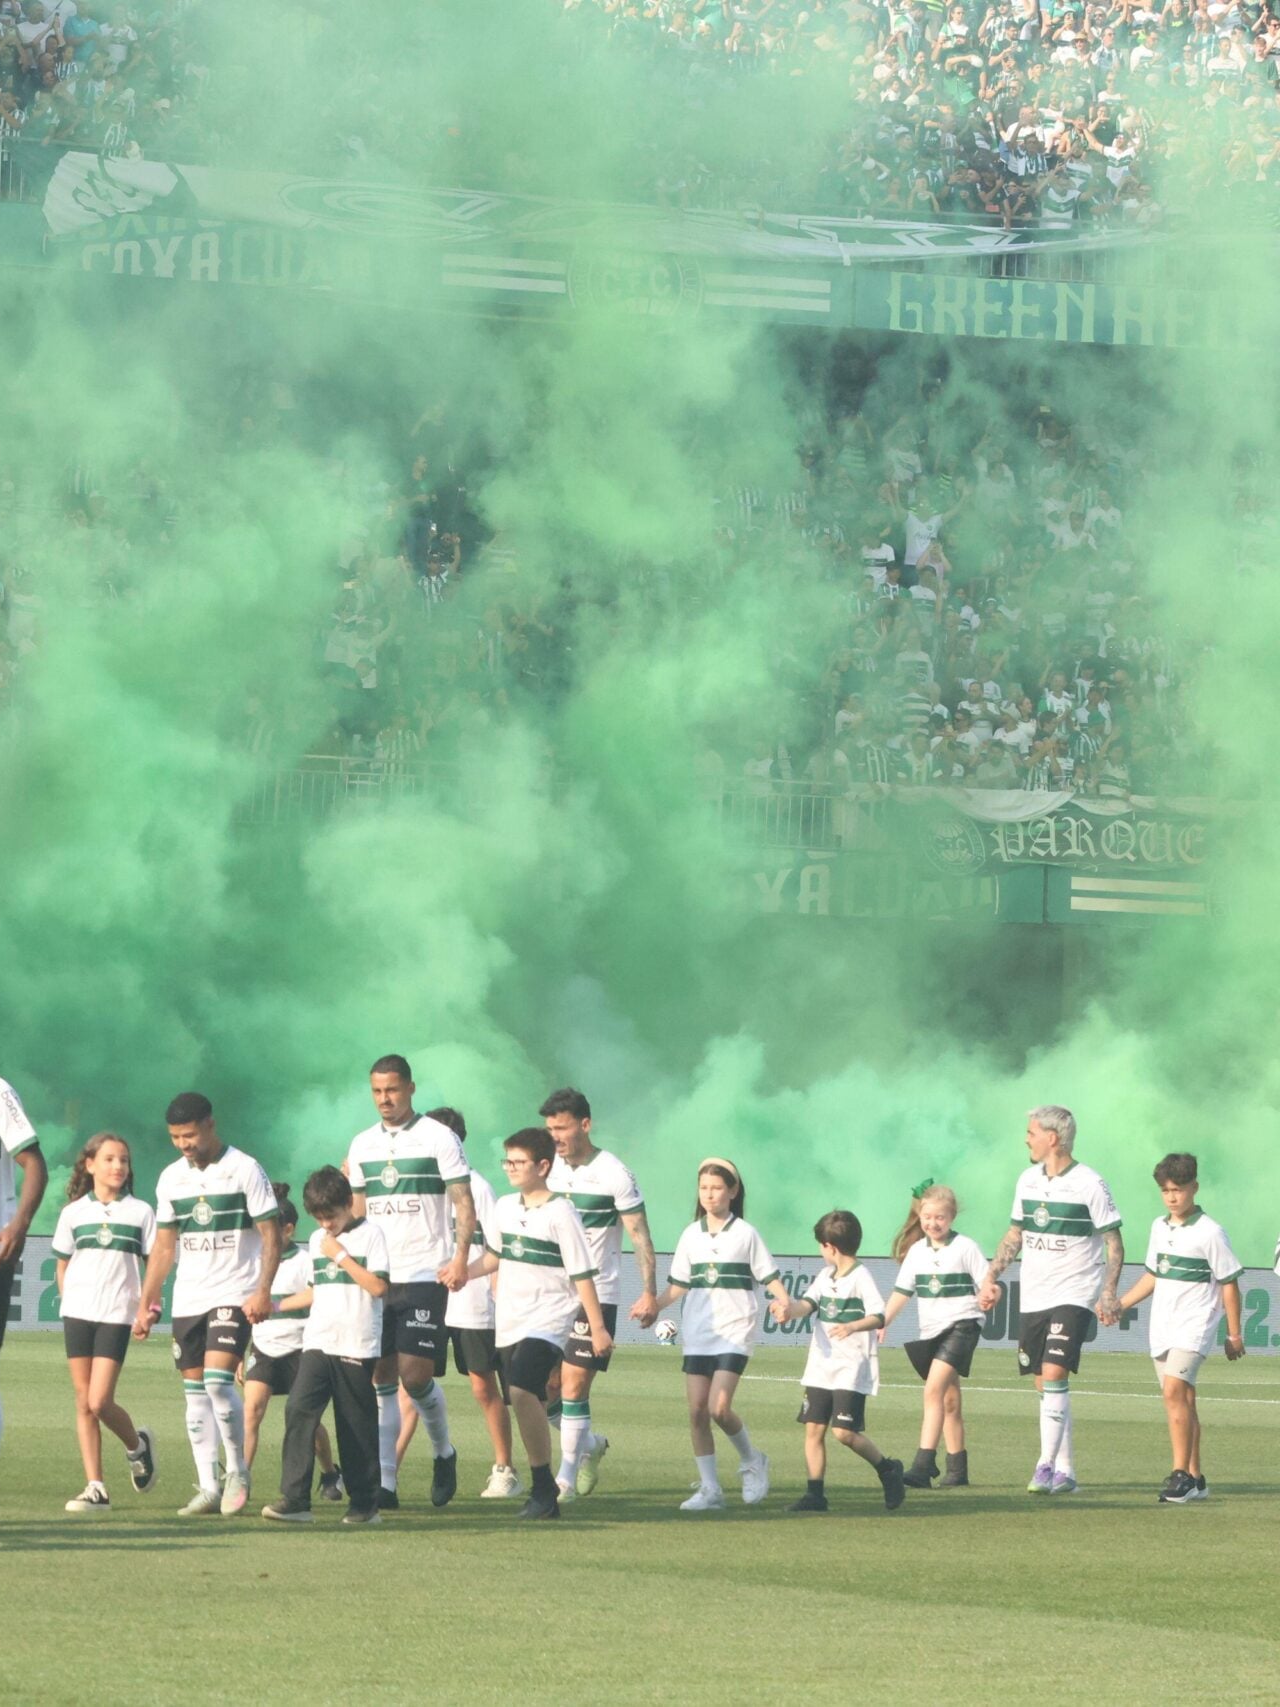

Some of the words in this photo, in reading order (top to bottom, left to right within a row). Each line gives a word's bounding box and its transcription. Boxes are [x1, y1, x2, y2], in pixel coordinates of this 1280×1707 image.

[889, 271, 1096, 343] GREEN
[991, 814, 1208, 864] PARQUE
[183, 1234, 236, 1251] REALS
